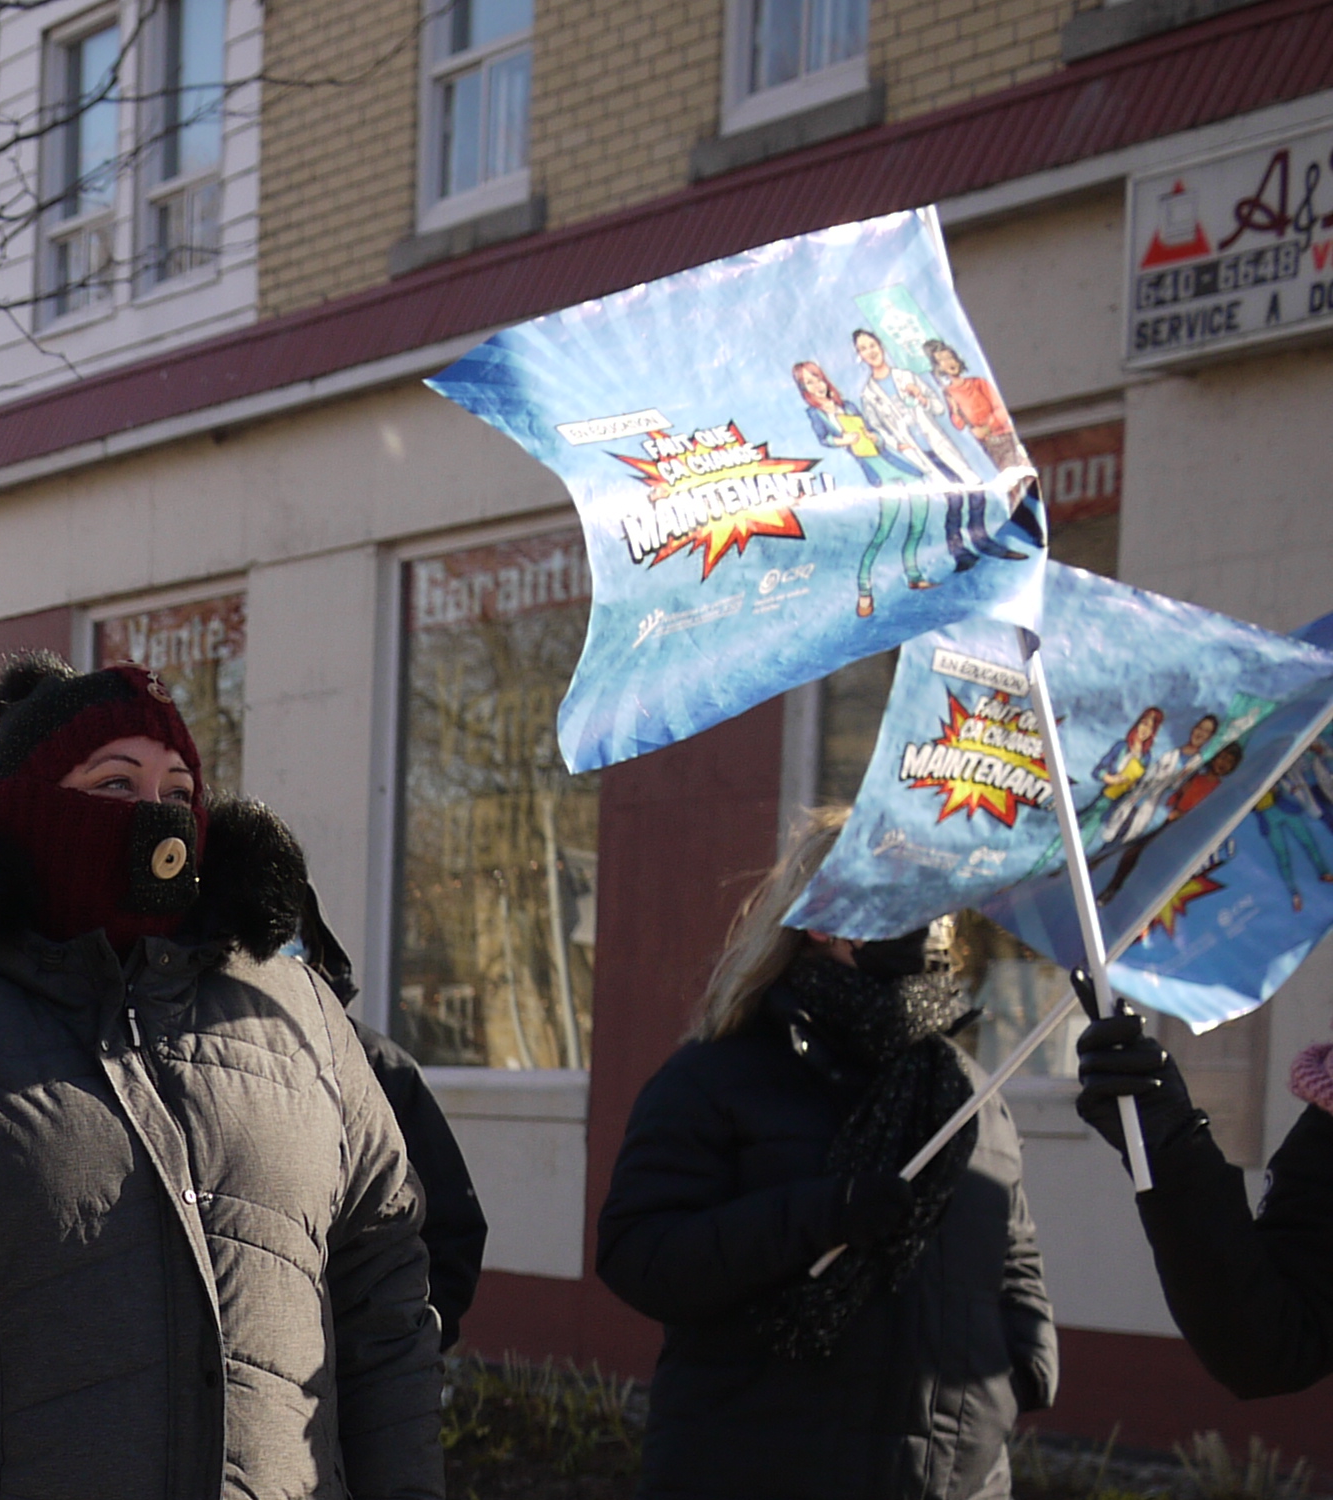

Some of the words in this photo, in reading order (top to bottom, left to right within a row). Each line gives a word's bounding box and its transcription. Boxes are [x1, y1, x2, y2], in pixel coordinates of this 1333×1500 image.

[1135, 300, 1242, 350] SERVICE
[644, 433, 690, 460] FAUT
[694, 425, 737, 448] QUE
[656, 459, 691, 486] ÇA
[686, 442, 763, 475] CHANGE
